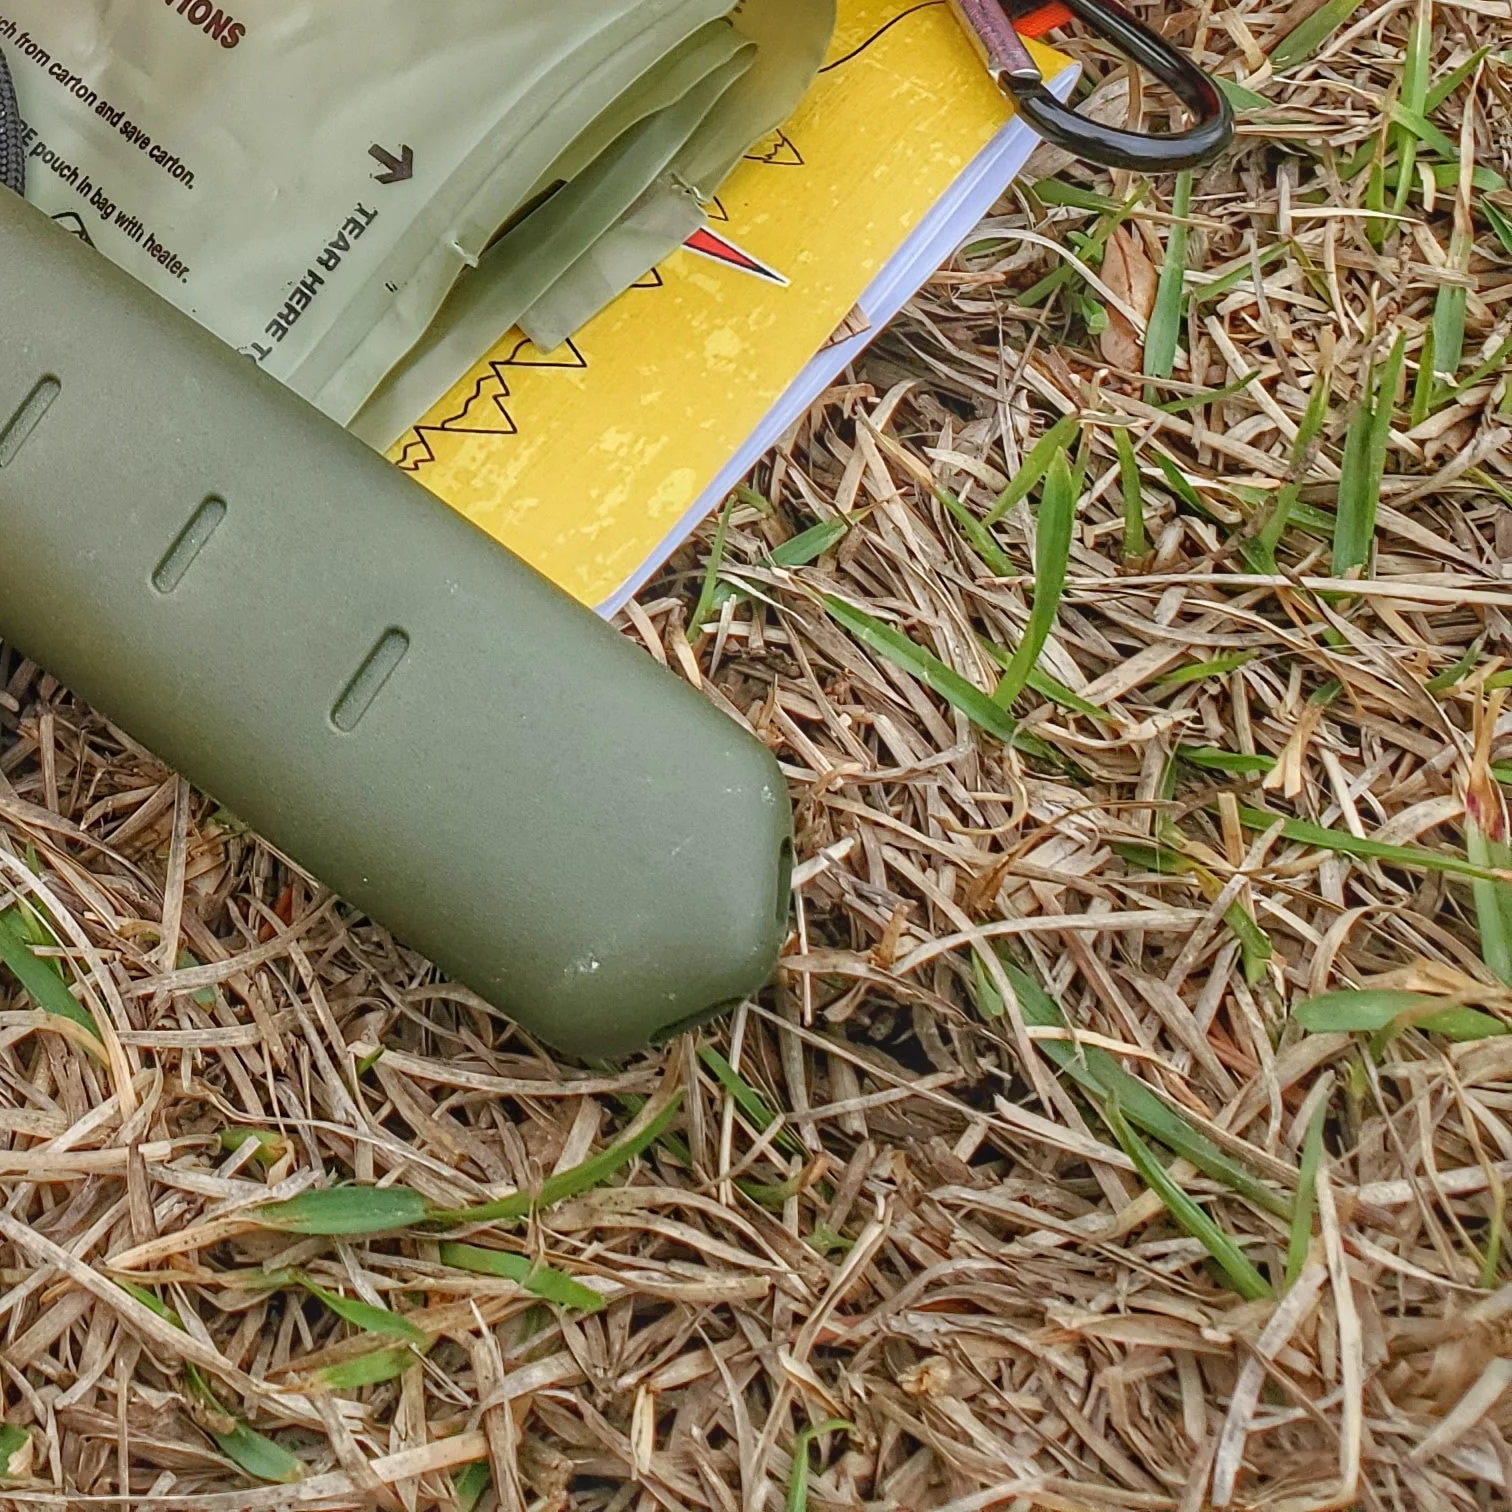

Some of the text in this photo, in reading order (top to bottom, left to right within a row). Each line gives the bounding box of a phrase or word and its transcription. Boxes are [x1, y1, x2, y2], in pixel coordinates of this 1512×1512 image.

[14, 32, 51, 68] from
[48, 62, 98, 107] carton
[95, 99, 125, 134] and
[119, 121, 150, 150] save
[148, 142, 194, 189] carton.
[29, 140, 80, 186] pouch
[76, 176, 92, 198] in
[90, 187, 116, 220] bag
[114, 210, 143, 243] with
[142, 233, 191, 284] heater.
[316, 202, 378, 272] TEAR
[265, 268, 325, 342] HERE
